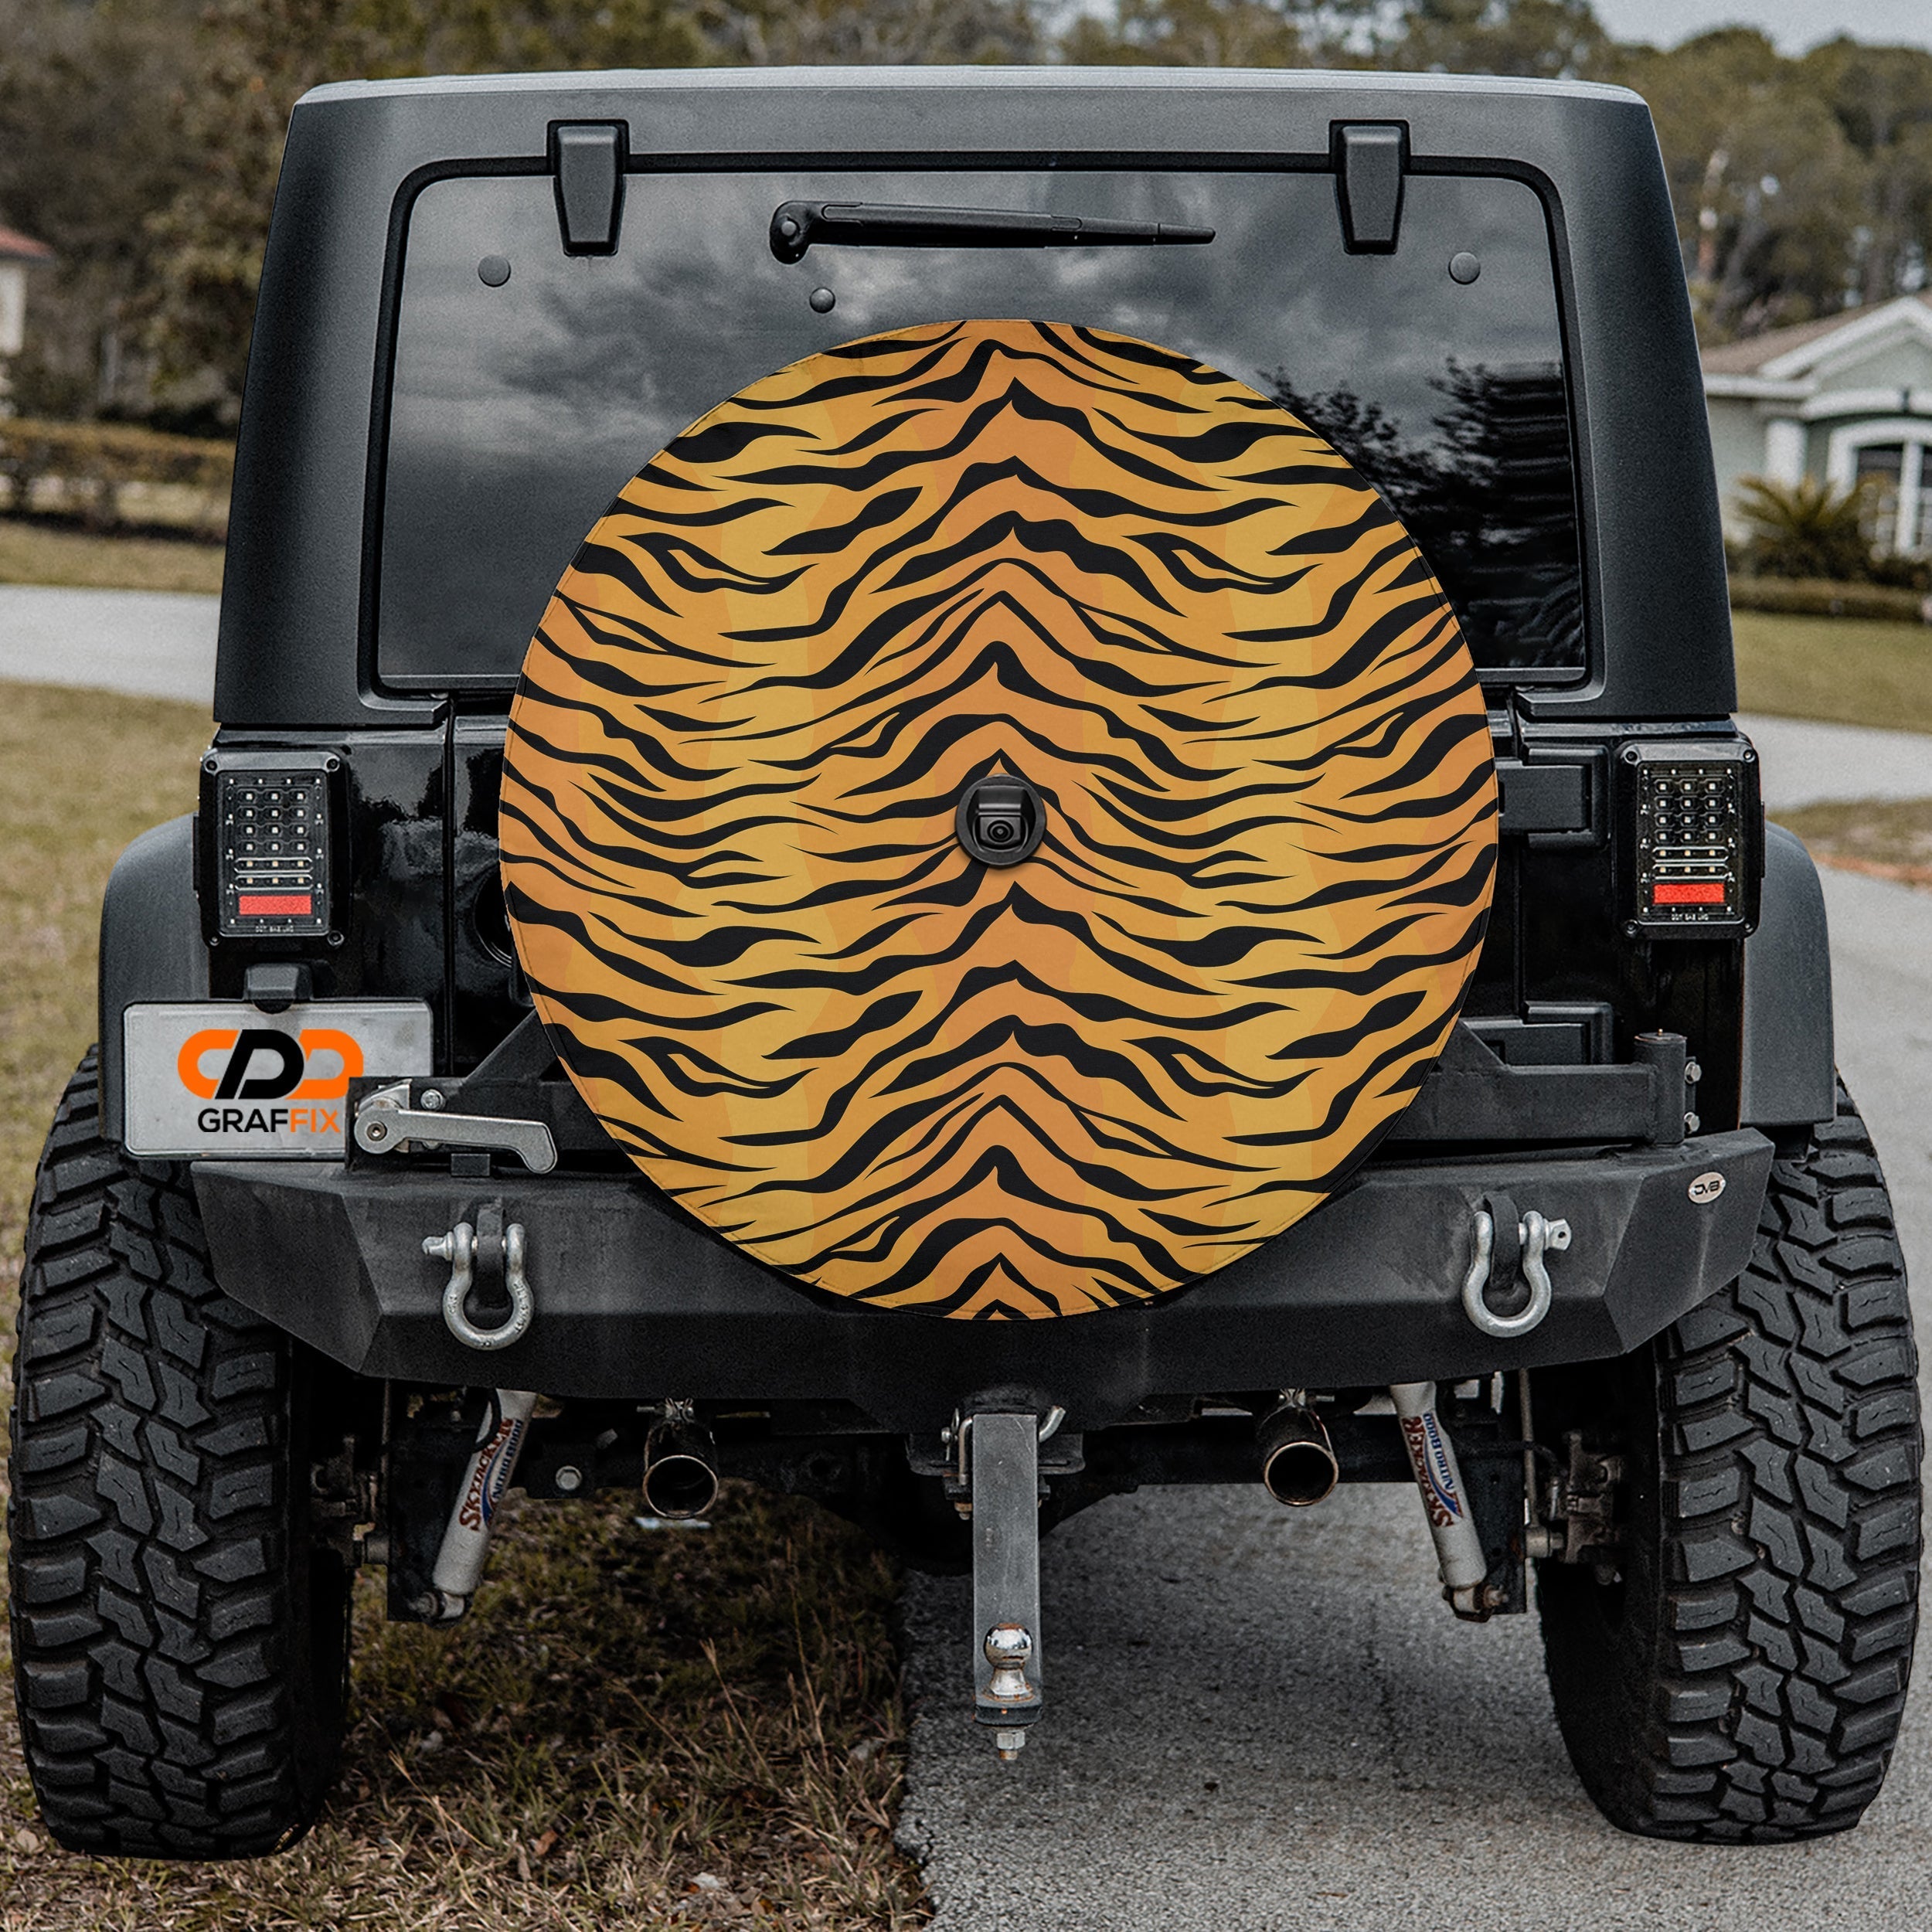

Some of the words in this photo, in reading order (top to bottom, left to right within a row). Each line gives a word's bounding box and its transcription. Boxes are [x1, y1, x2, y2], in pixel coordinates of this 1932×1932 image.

[198, 1108, 341, 1133] GRAFFIX
[1402, 1415, 1455, 1527] SKYJACKER
[1435, 1451, 1455, 1492] NITRO
